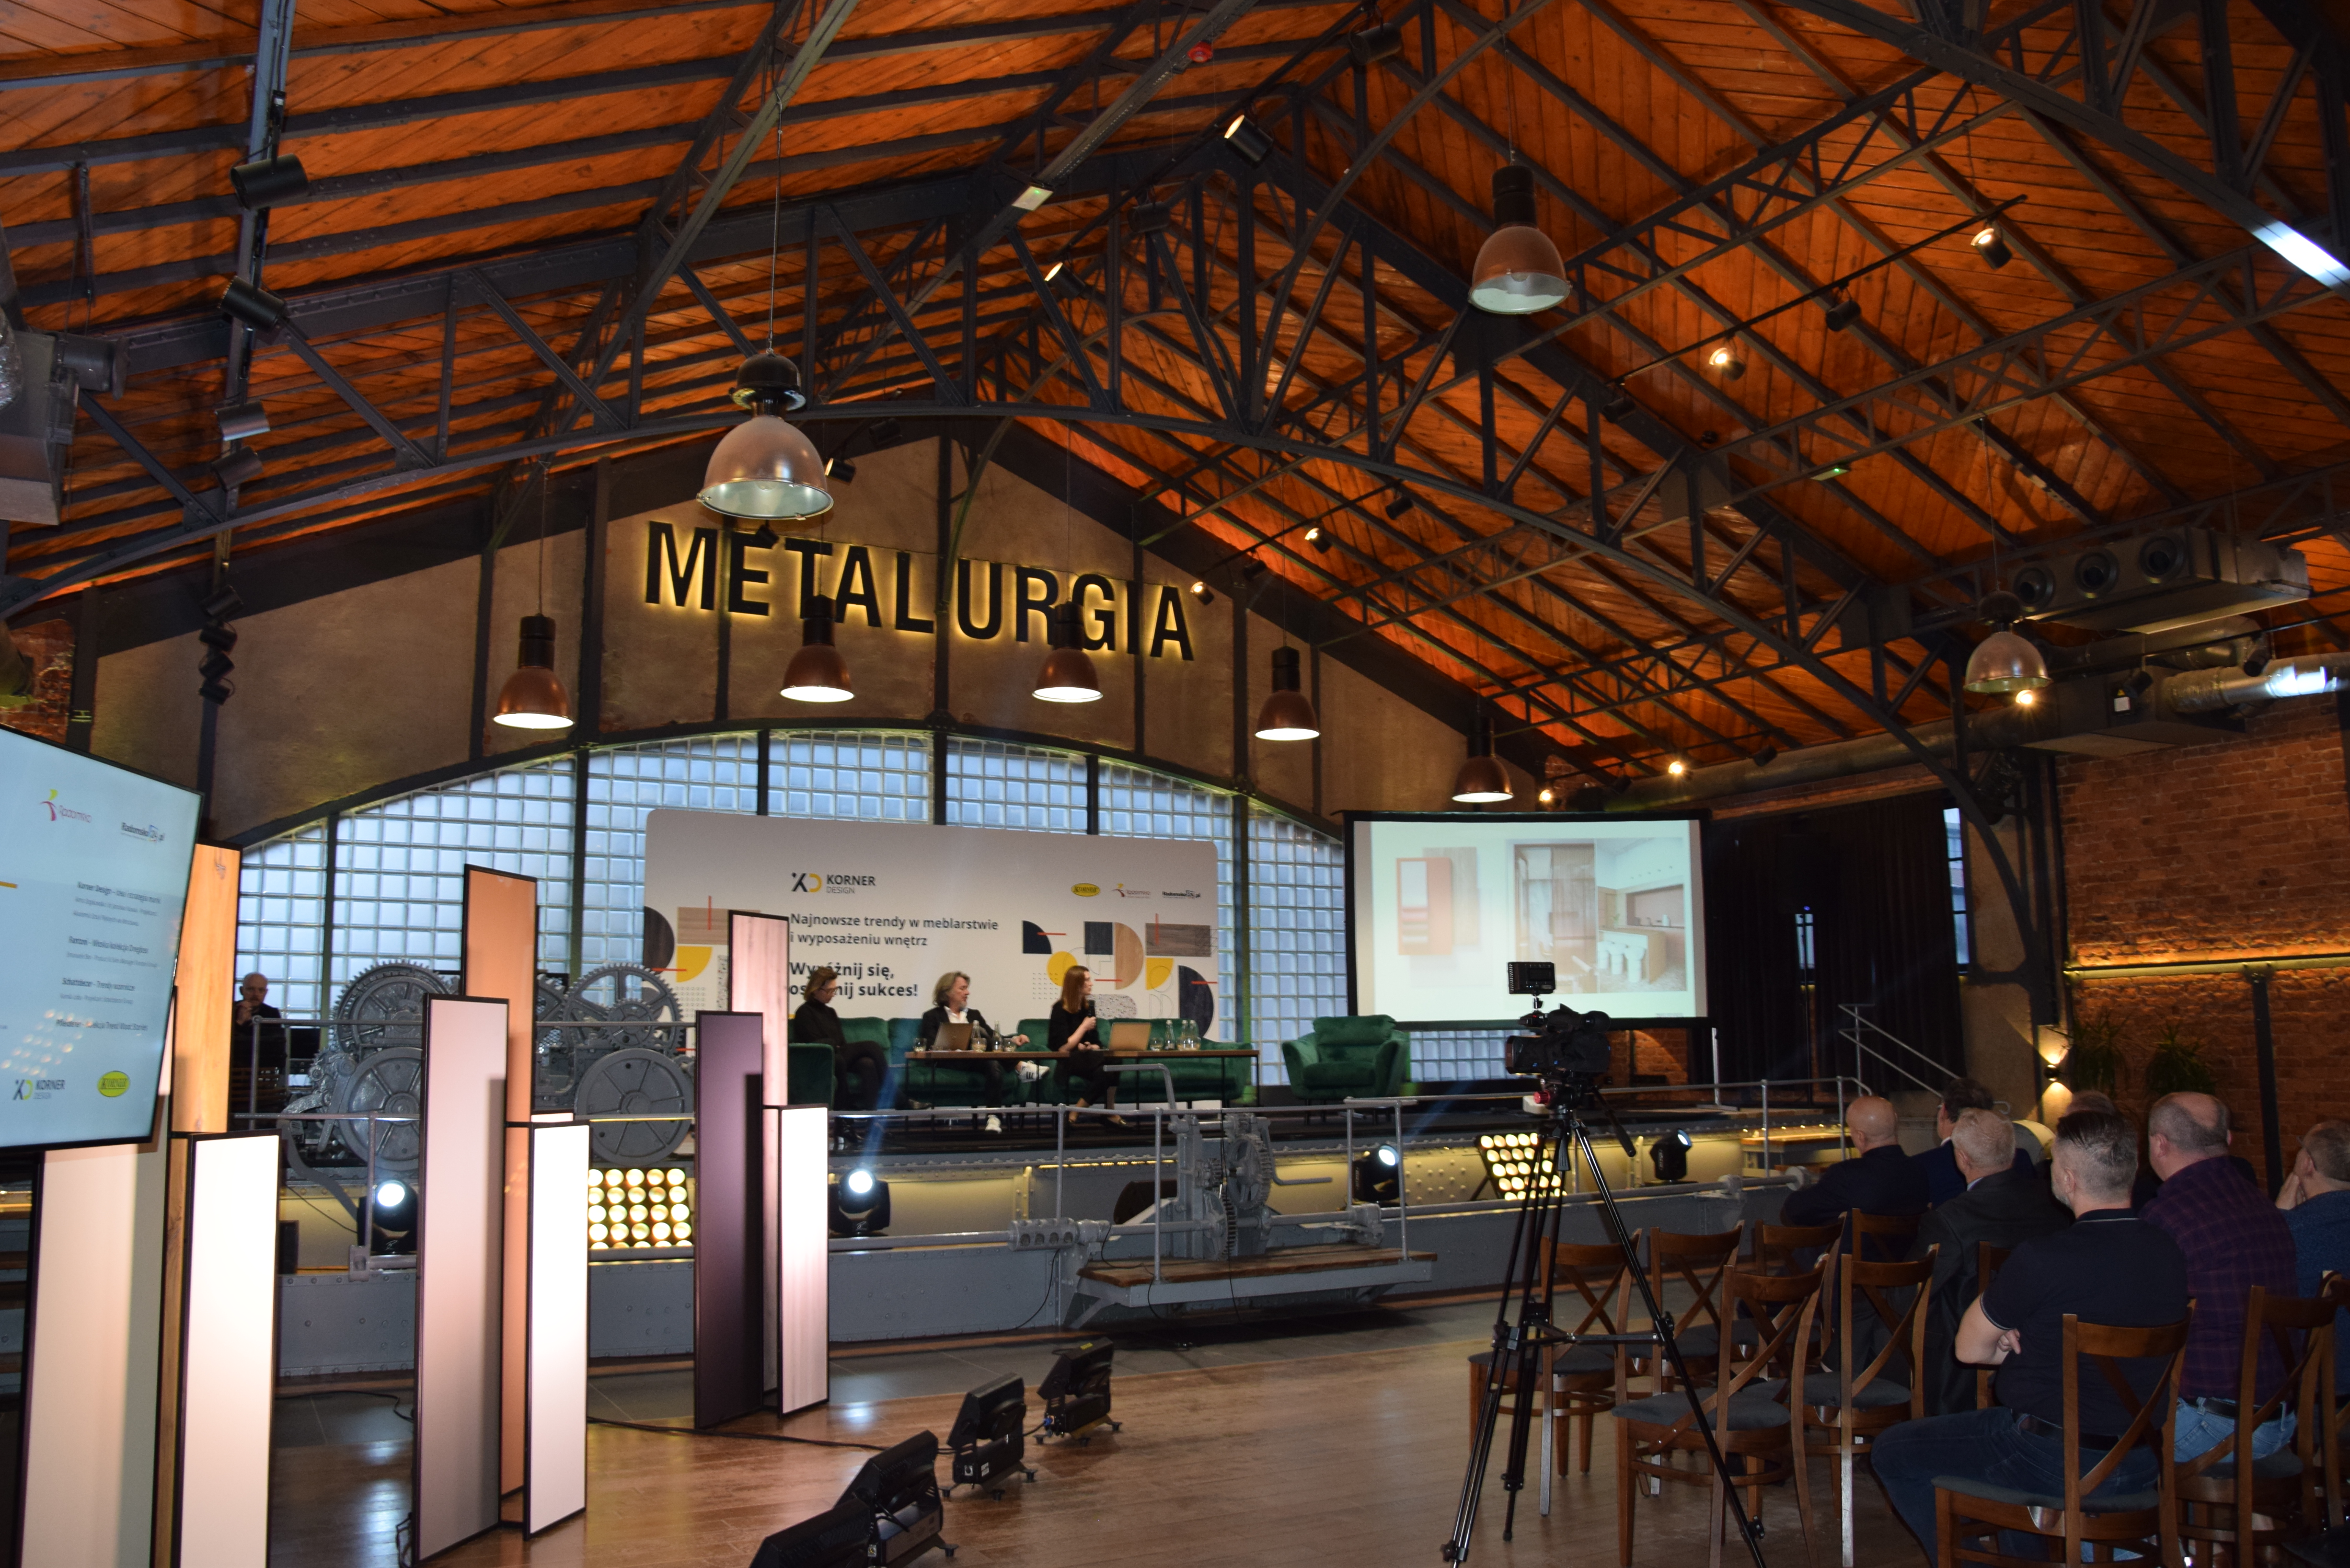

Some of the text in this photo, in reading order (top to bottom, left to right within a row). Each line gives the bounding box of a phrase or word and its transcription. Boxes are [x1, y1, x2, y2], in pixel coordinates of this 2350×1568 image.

[644, 520, 1194, 662] METALURGIA
[826, 874, 876, 886] KORNER
[790, 913, 999, 930] Najnowsze trendy w meblarstwie
[790, 932, 928, 948] i wyposażeniu wnętrz
[867, 963, 895, 980] się,
[789, 982, 919, 999] osnij sukces!
[35, 1079, 66, 1090] KORNER
